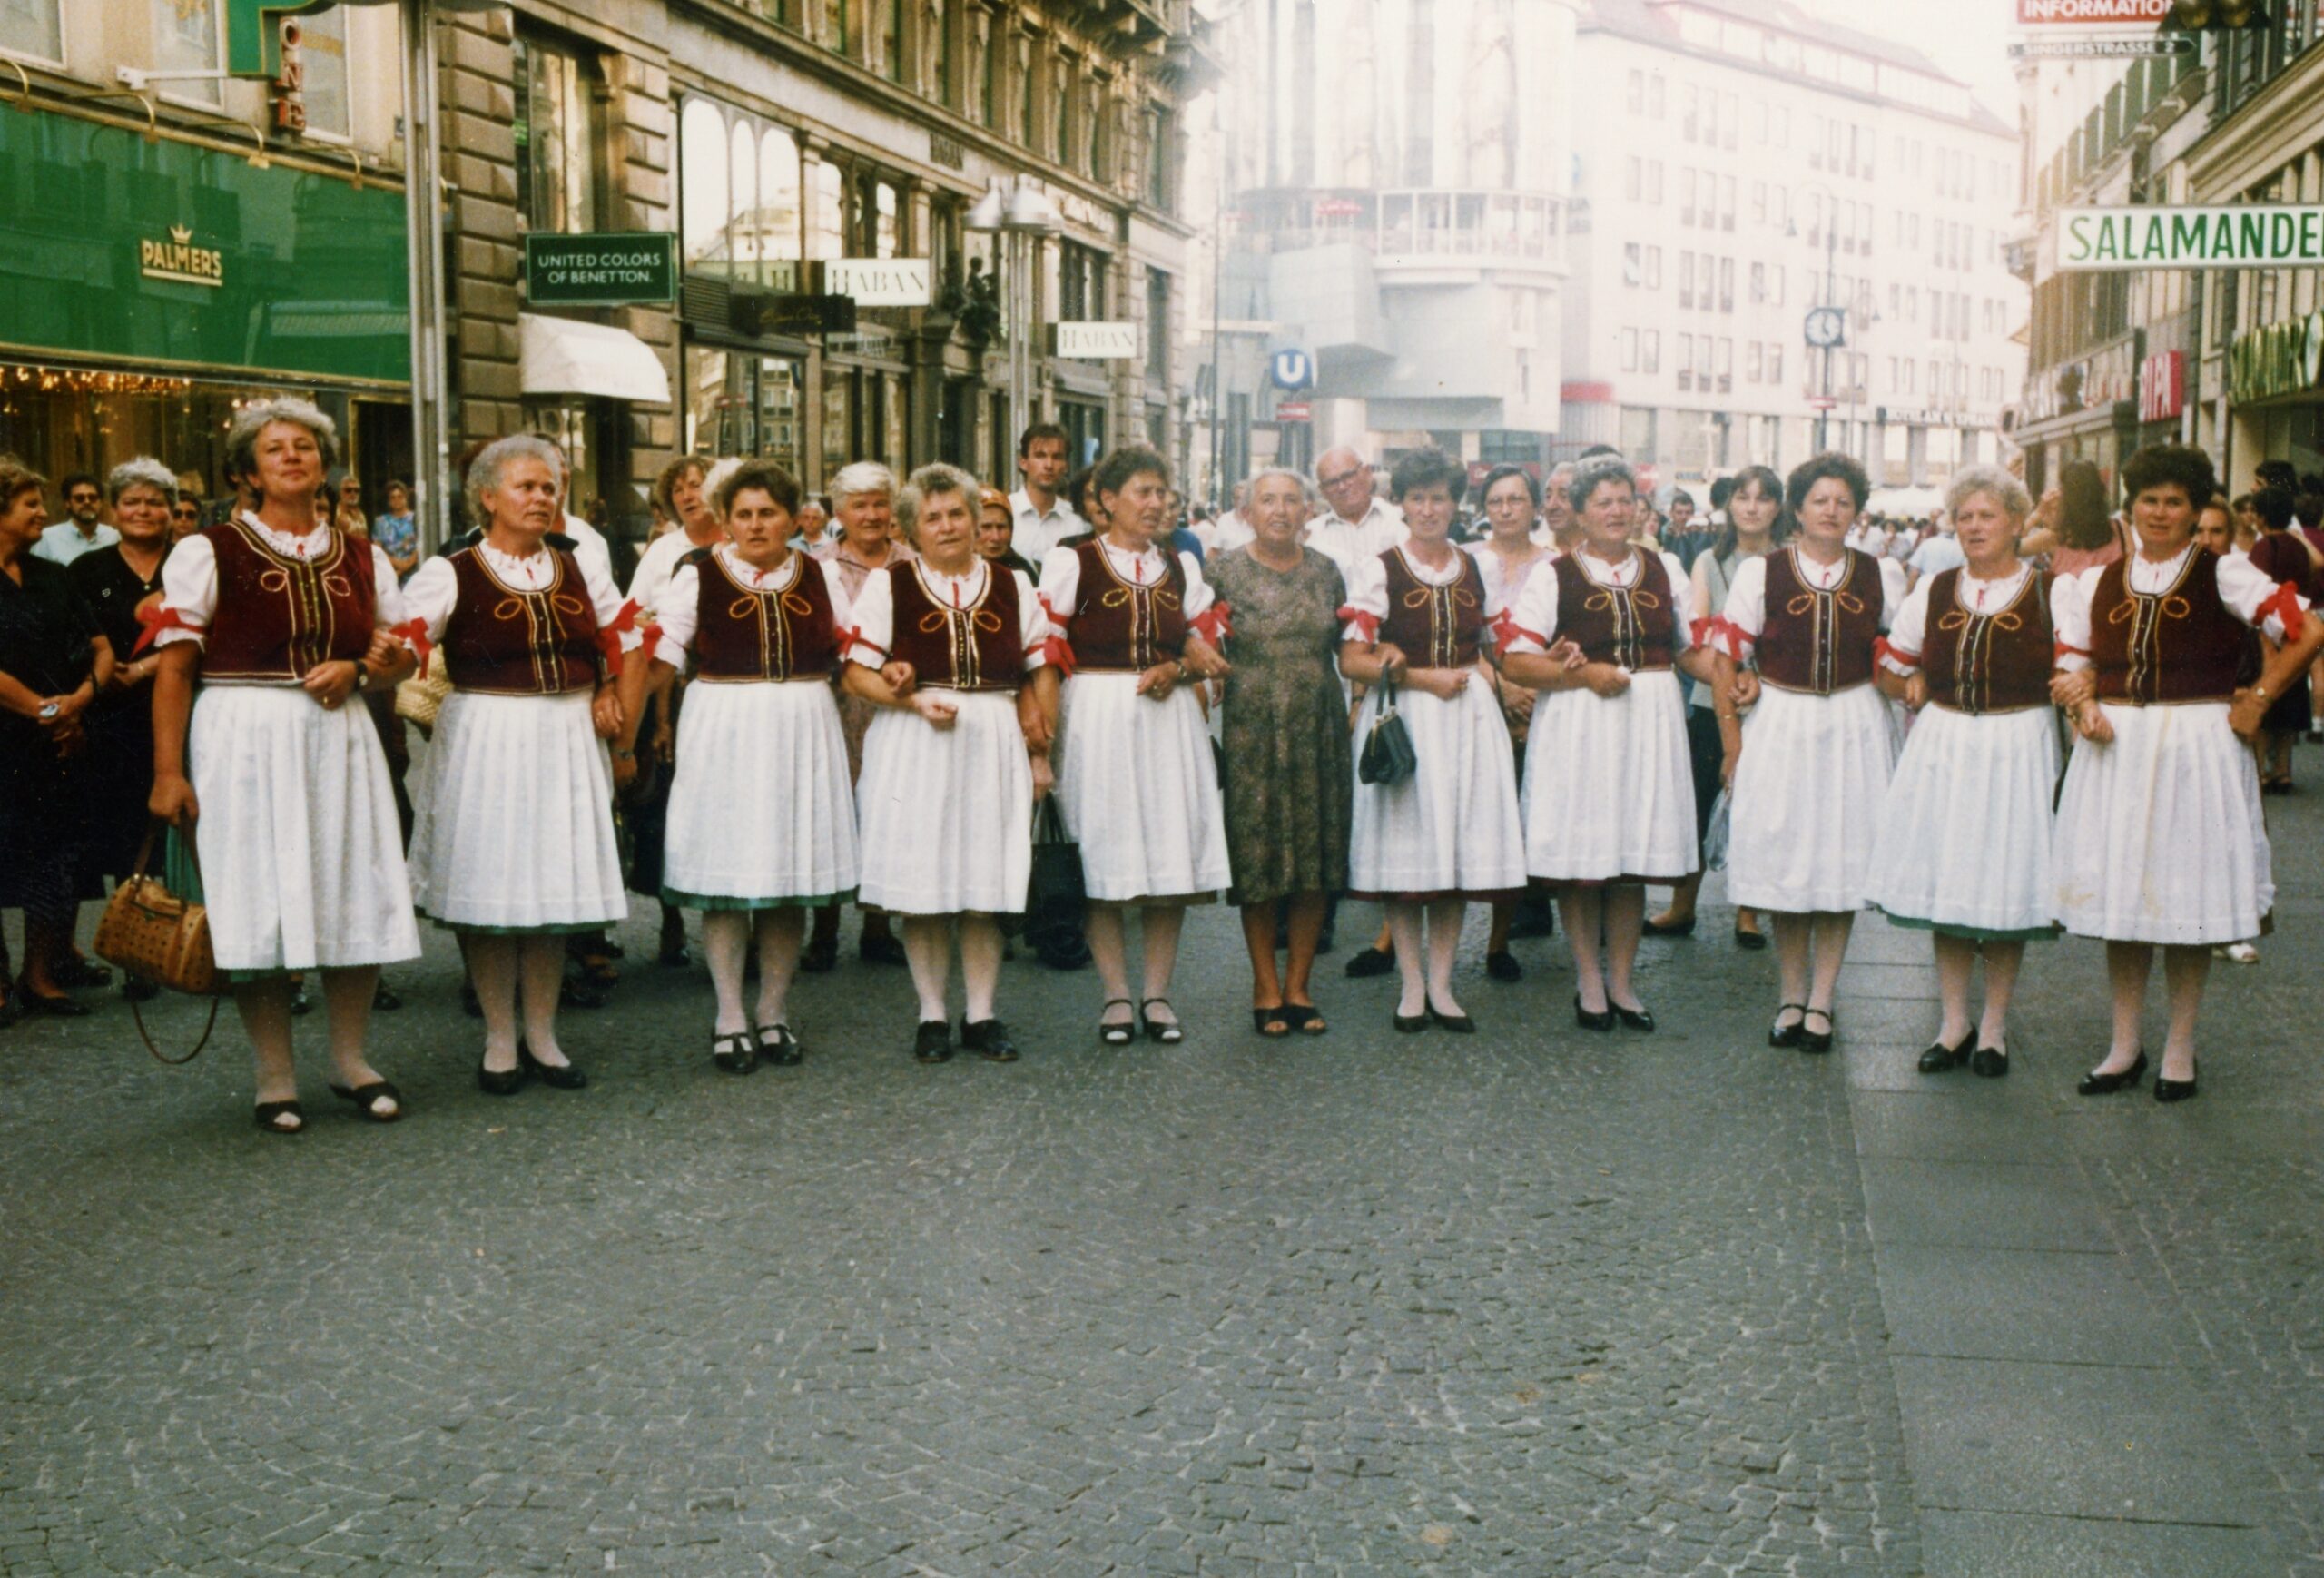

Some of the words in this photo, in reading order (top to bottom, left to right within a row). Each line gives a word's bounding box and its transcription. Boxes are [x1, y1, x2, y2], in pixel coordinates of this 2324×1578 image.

[2067, 212, 2324, 261] SALAMANDE
[142, 239, 222, 278] PALMERS
[537, 253, 596, 268] UNITED
[599, 252, 661, 267] COLORS
[547, 271, 567, 284] OF
[831, 269, 926, 295] HABAN
[1062, 329, 1134, 350] HABAN
[1277, 354, 1305, 383] U
